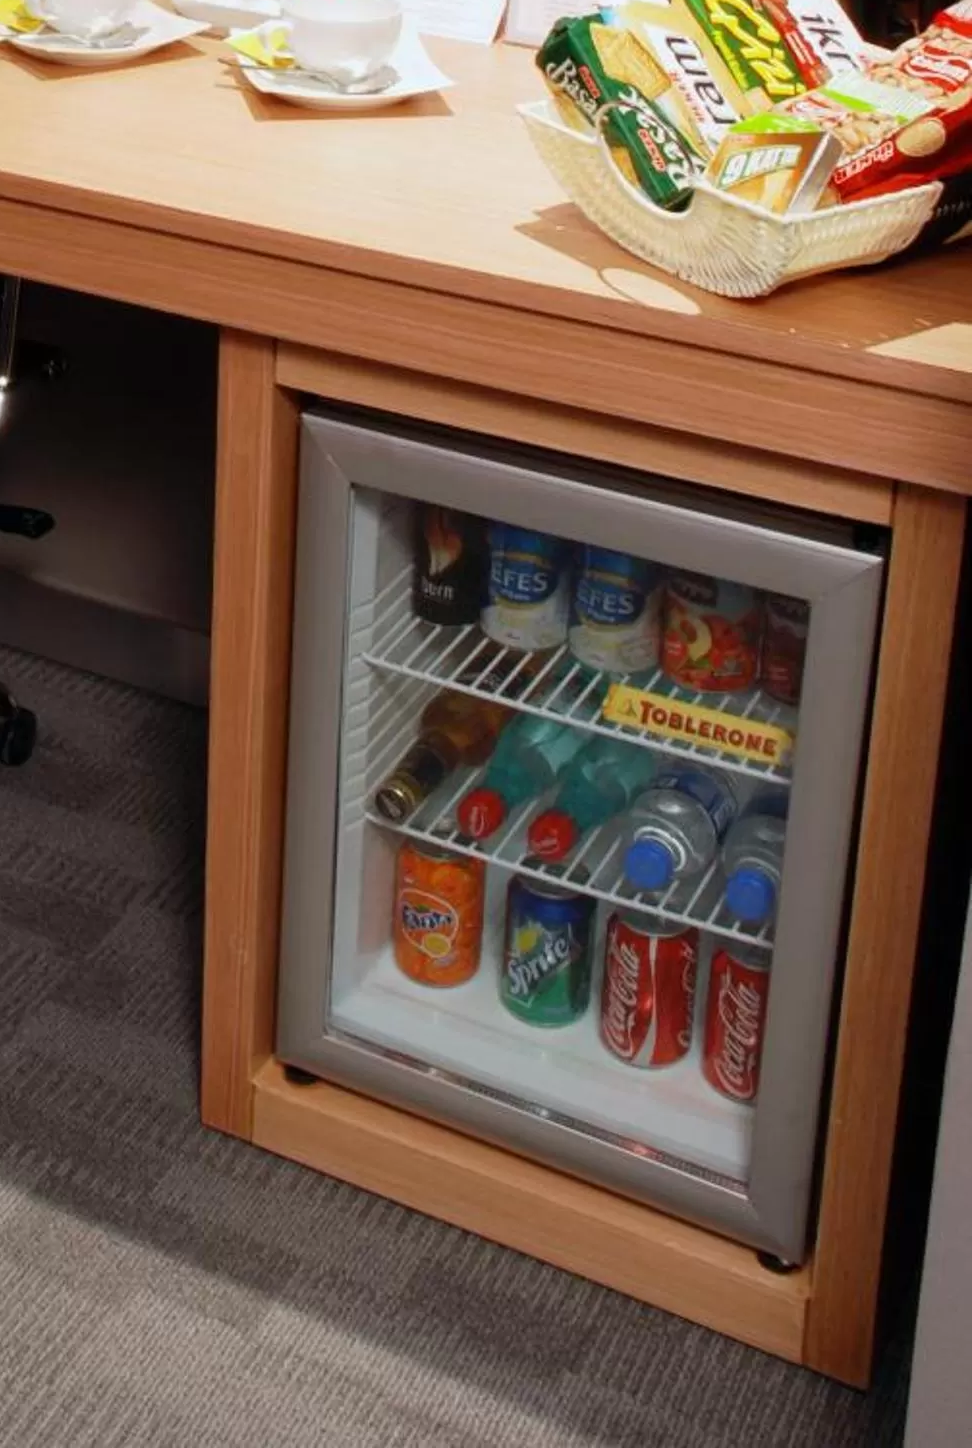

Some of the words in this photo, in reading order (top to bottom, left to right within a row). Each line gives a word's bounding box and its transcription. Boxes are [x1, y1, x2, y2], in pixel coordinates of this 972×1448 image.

[491, 559, 548, 593] EFES
[640, 699, 778, 757] TOBLERONE
[402, 905, 453, 930] Fanta
[508, 930, 569, 995] Sprite
